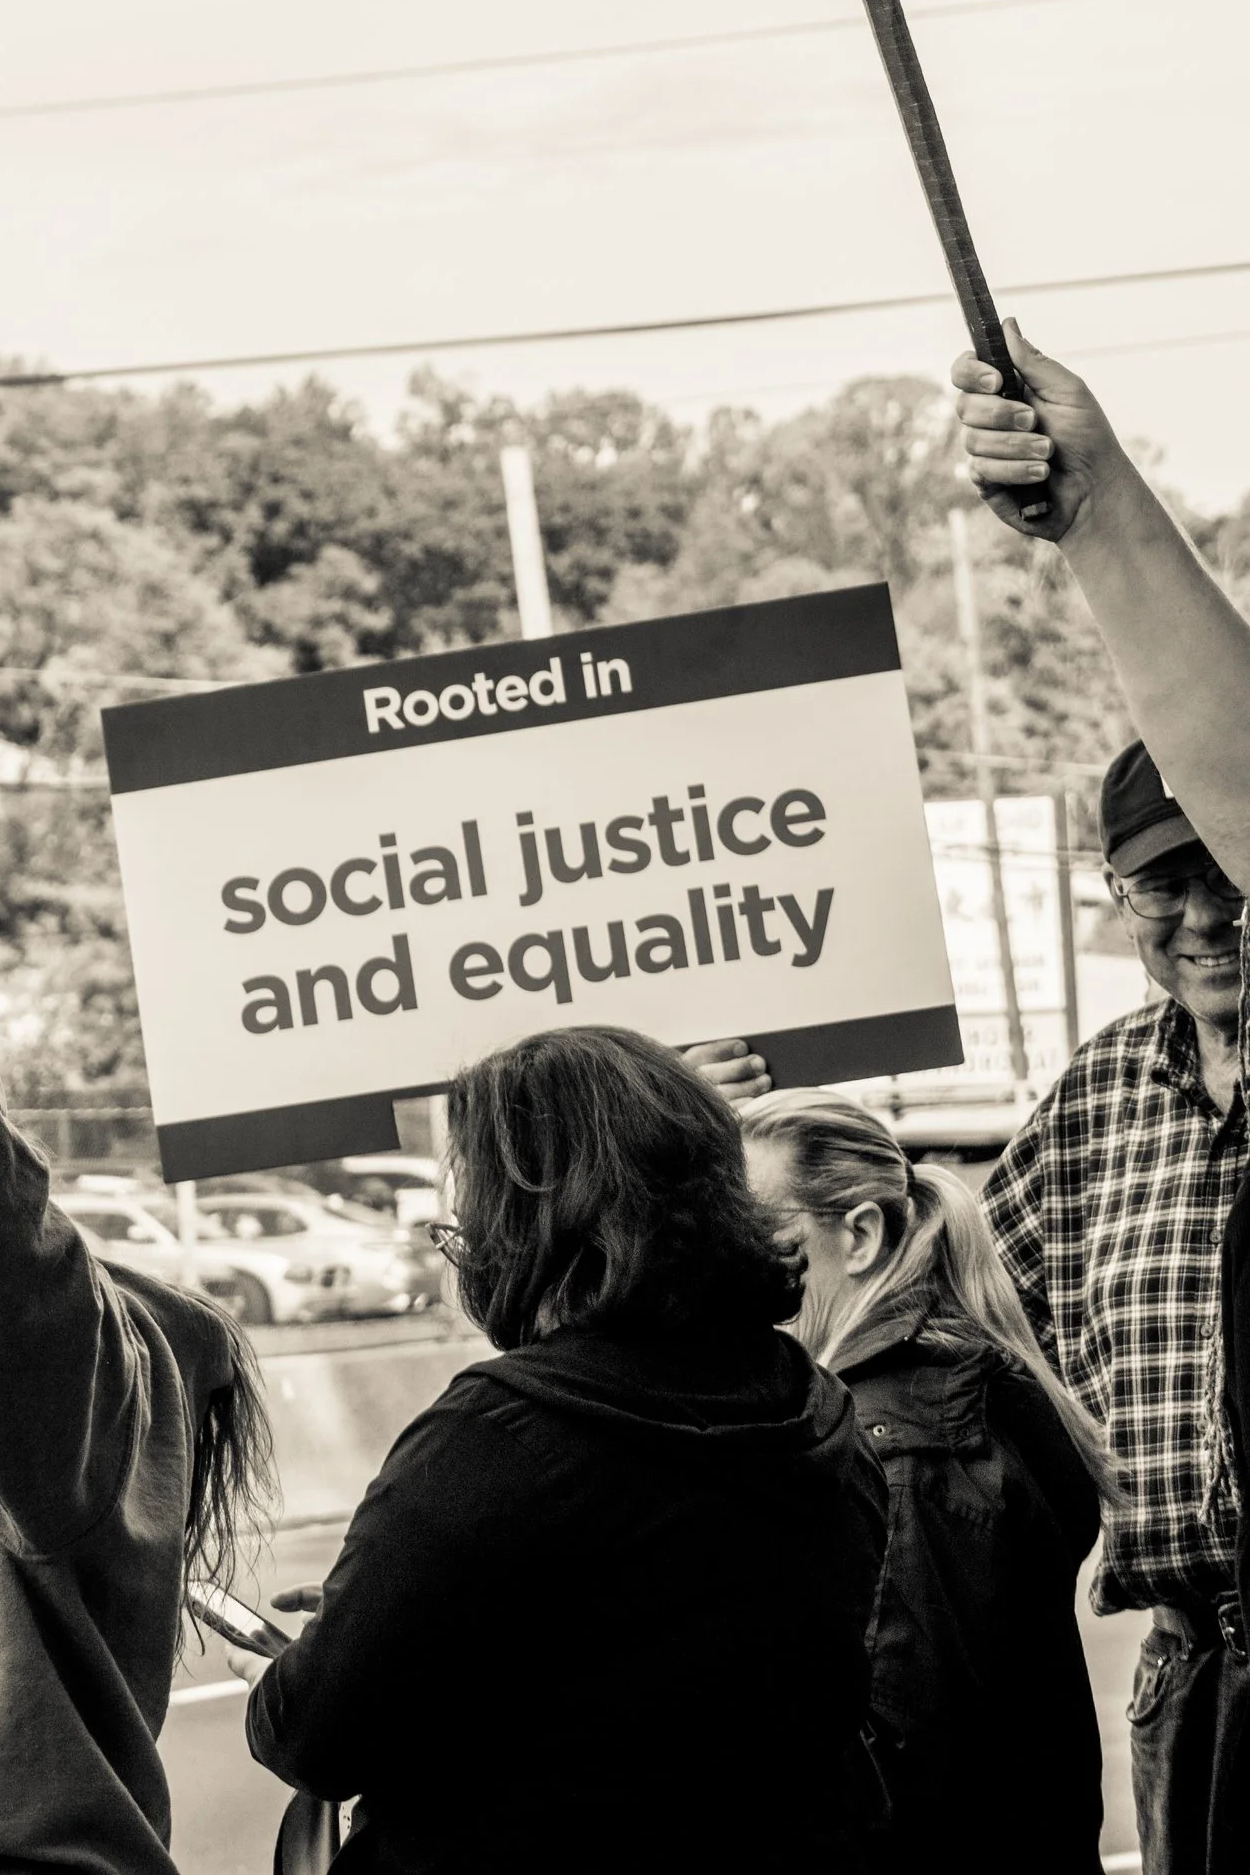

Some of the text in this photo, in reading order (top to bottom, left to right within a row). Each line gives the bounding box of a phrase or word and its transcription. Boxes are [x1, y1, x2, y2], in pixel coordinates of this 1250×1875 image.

[362, 651, 633, 733] Rooted in
[220, 783, 828, 936] social justice
[240, 883, 836, 1036] and equality
